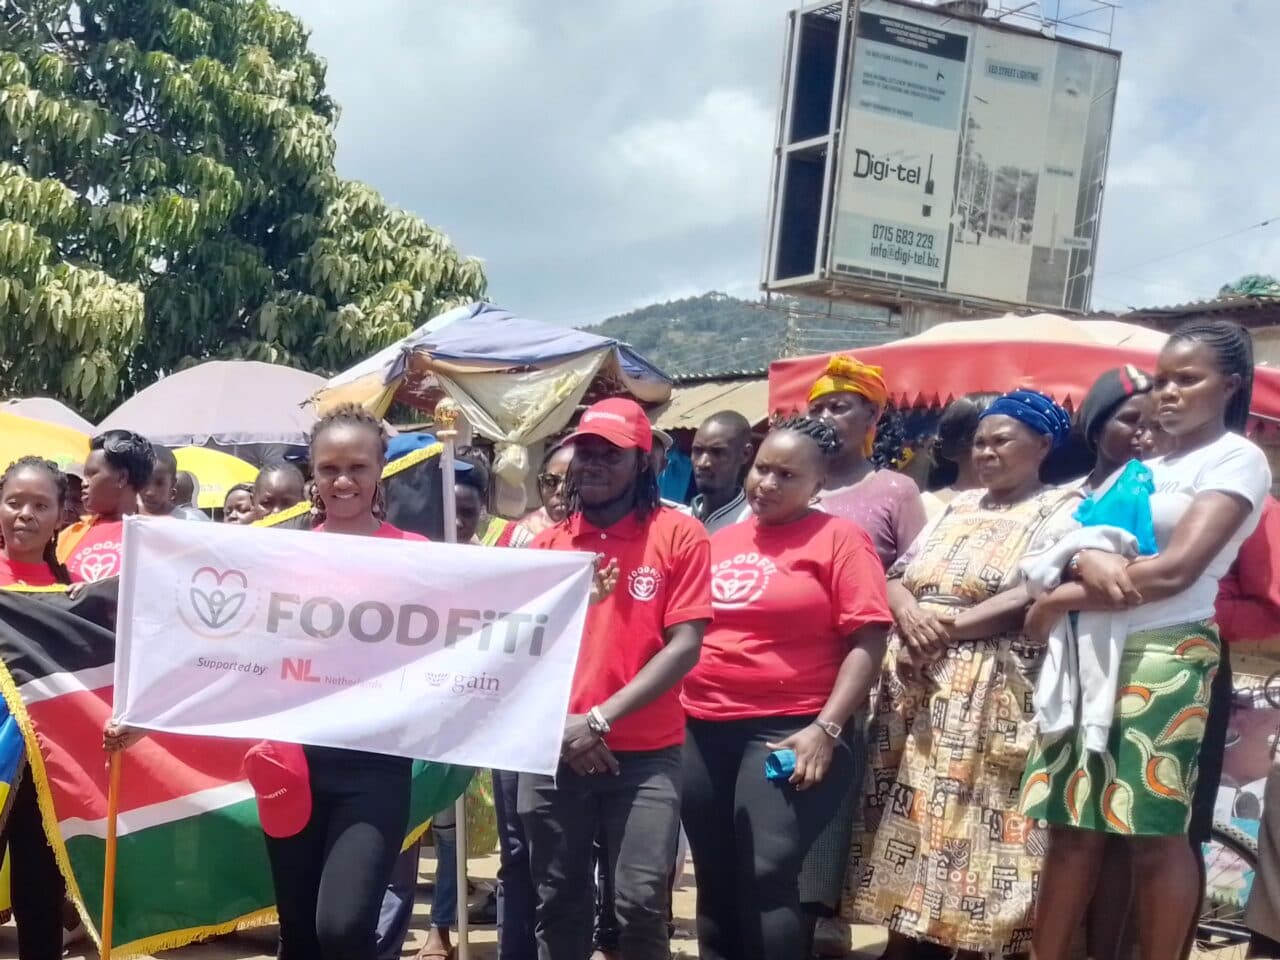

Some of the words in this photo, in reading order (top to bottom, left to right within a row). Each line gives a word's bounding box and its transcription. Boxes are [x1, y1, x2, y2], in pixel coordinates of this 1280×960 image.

[853, 148, 922, 185] Digi-tel
[872, 224, 894, 242] 0715
[895, 228, 914, 246] 683
[916, 232, 934, 250] 229
[870, 243, 940, 268] info@digi-tel.biz
[196, 656, 252, 673] Supported
[280, 657, 321, 683] NL
[451, 671, 500, 696] gain
